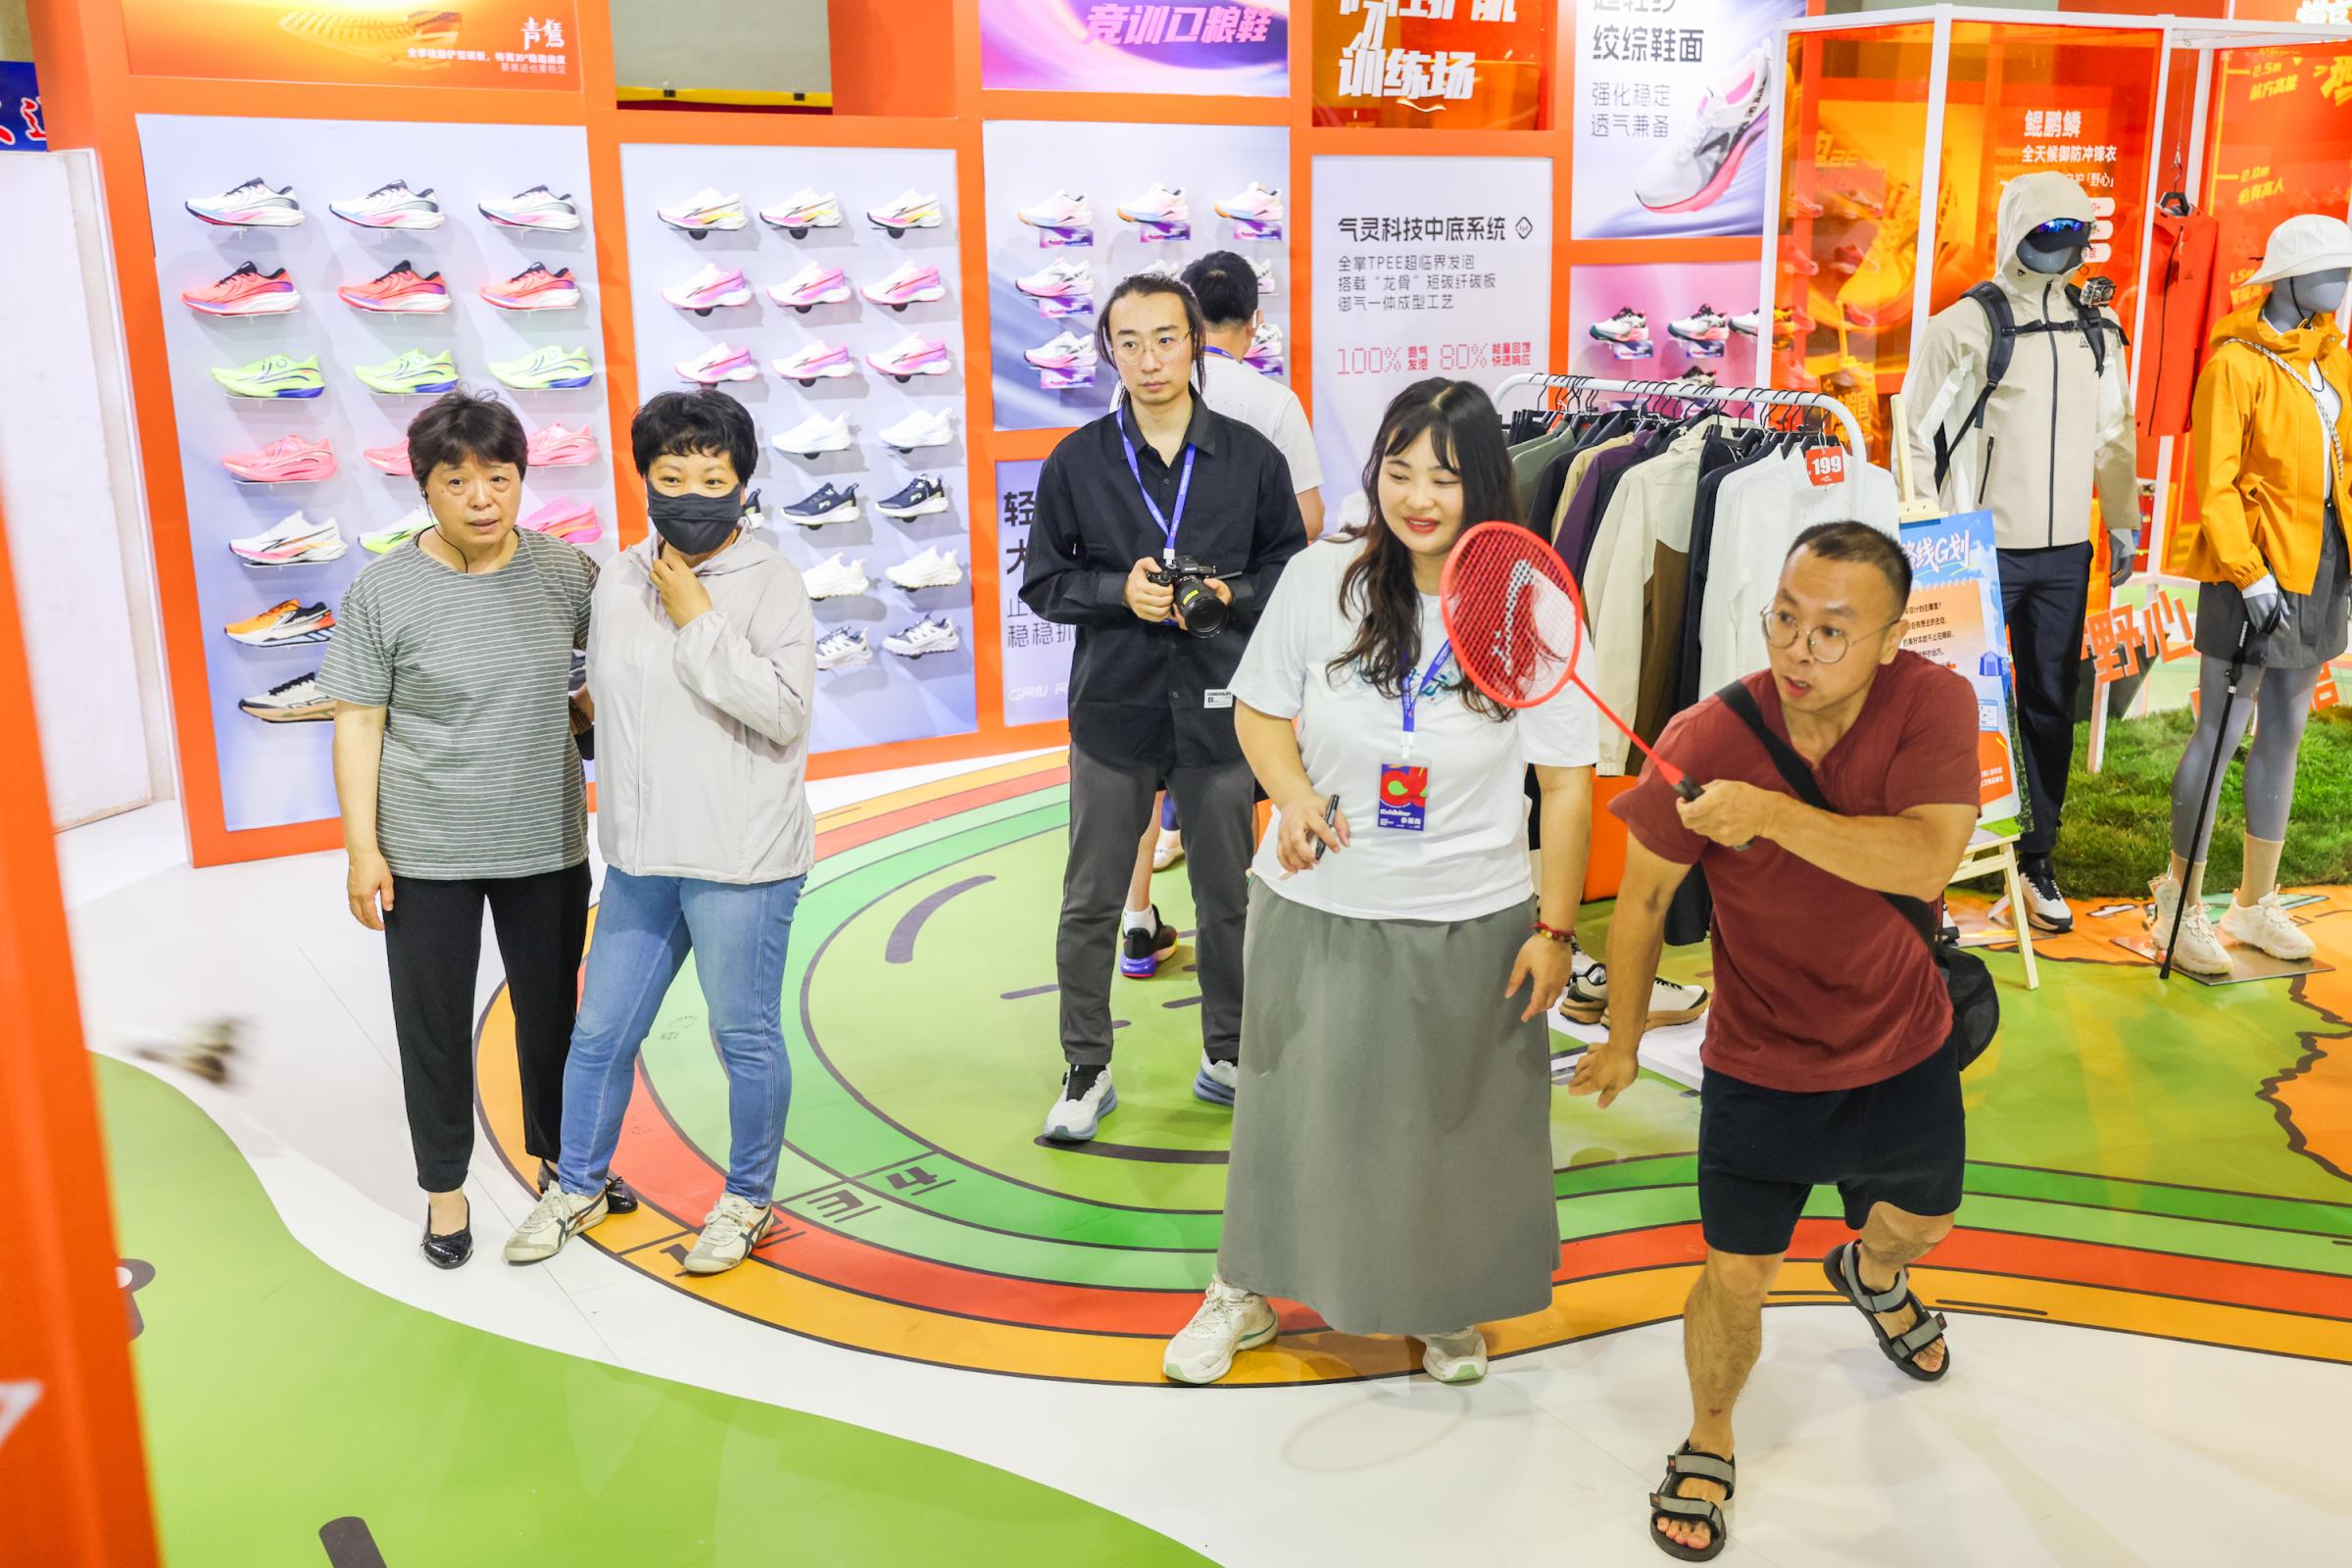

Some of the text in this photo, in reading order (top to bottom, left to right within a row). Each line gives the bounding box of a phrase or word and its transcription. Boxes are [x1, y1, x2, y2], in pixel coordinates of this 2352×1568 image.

[1083, 4, 1272, 45] 竞训口粮鞋
[1592, 24, 1704, 63] 绞综鞋面
[1339, 47, 1476, 99] 训练场
[1592, 81, 1671, 108] 强化稳定
[1592, 113, 1670, 138] 透气兼备
[2024, 110, 2082, 138] 鲲鹏鳞
[2022, 144, 2118, 164] 全天候御防冲锋衣
[1338, 217, 1506, 242] 气灵科技中底系统
[1338, 347, 1402, 375] 100%
[1440, 343, 1488, 370] 80%
[1811, 455, 1842, 475] 199
[1004, 490, 1036, 526] 轻
[1007, 620, 1076, 649] 稳稳抓
[2080, 589, 2195, 684] 野心
